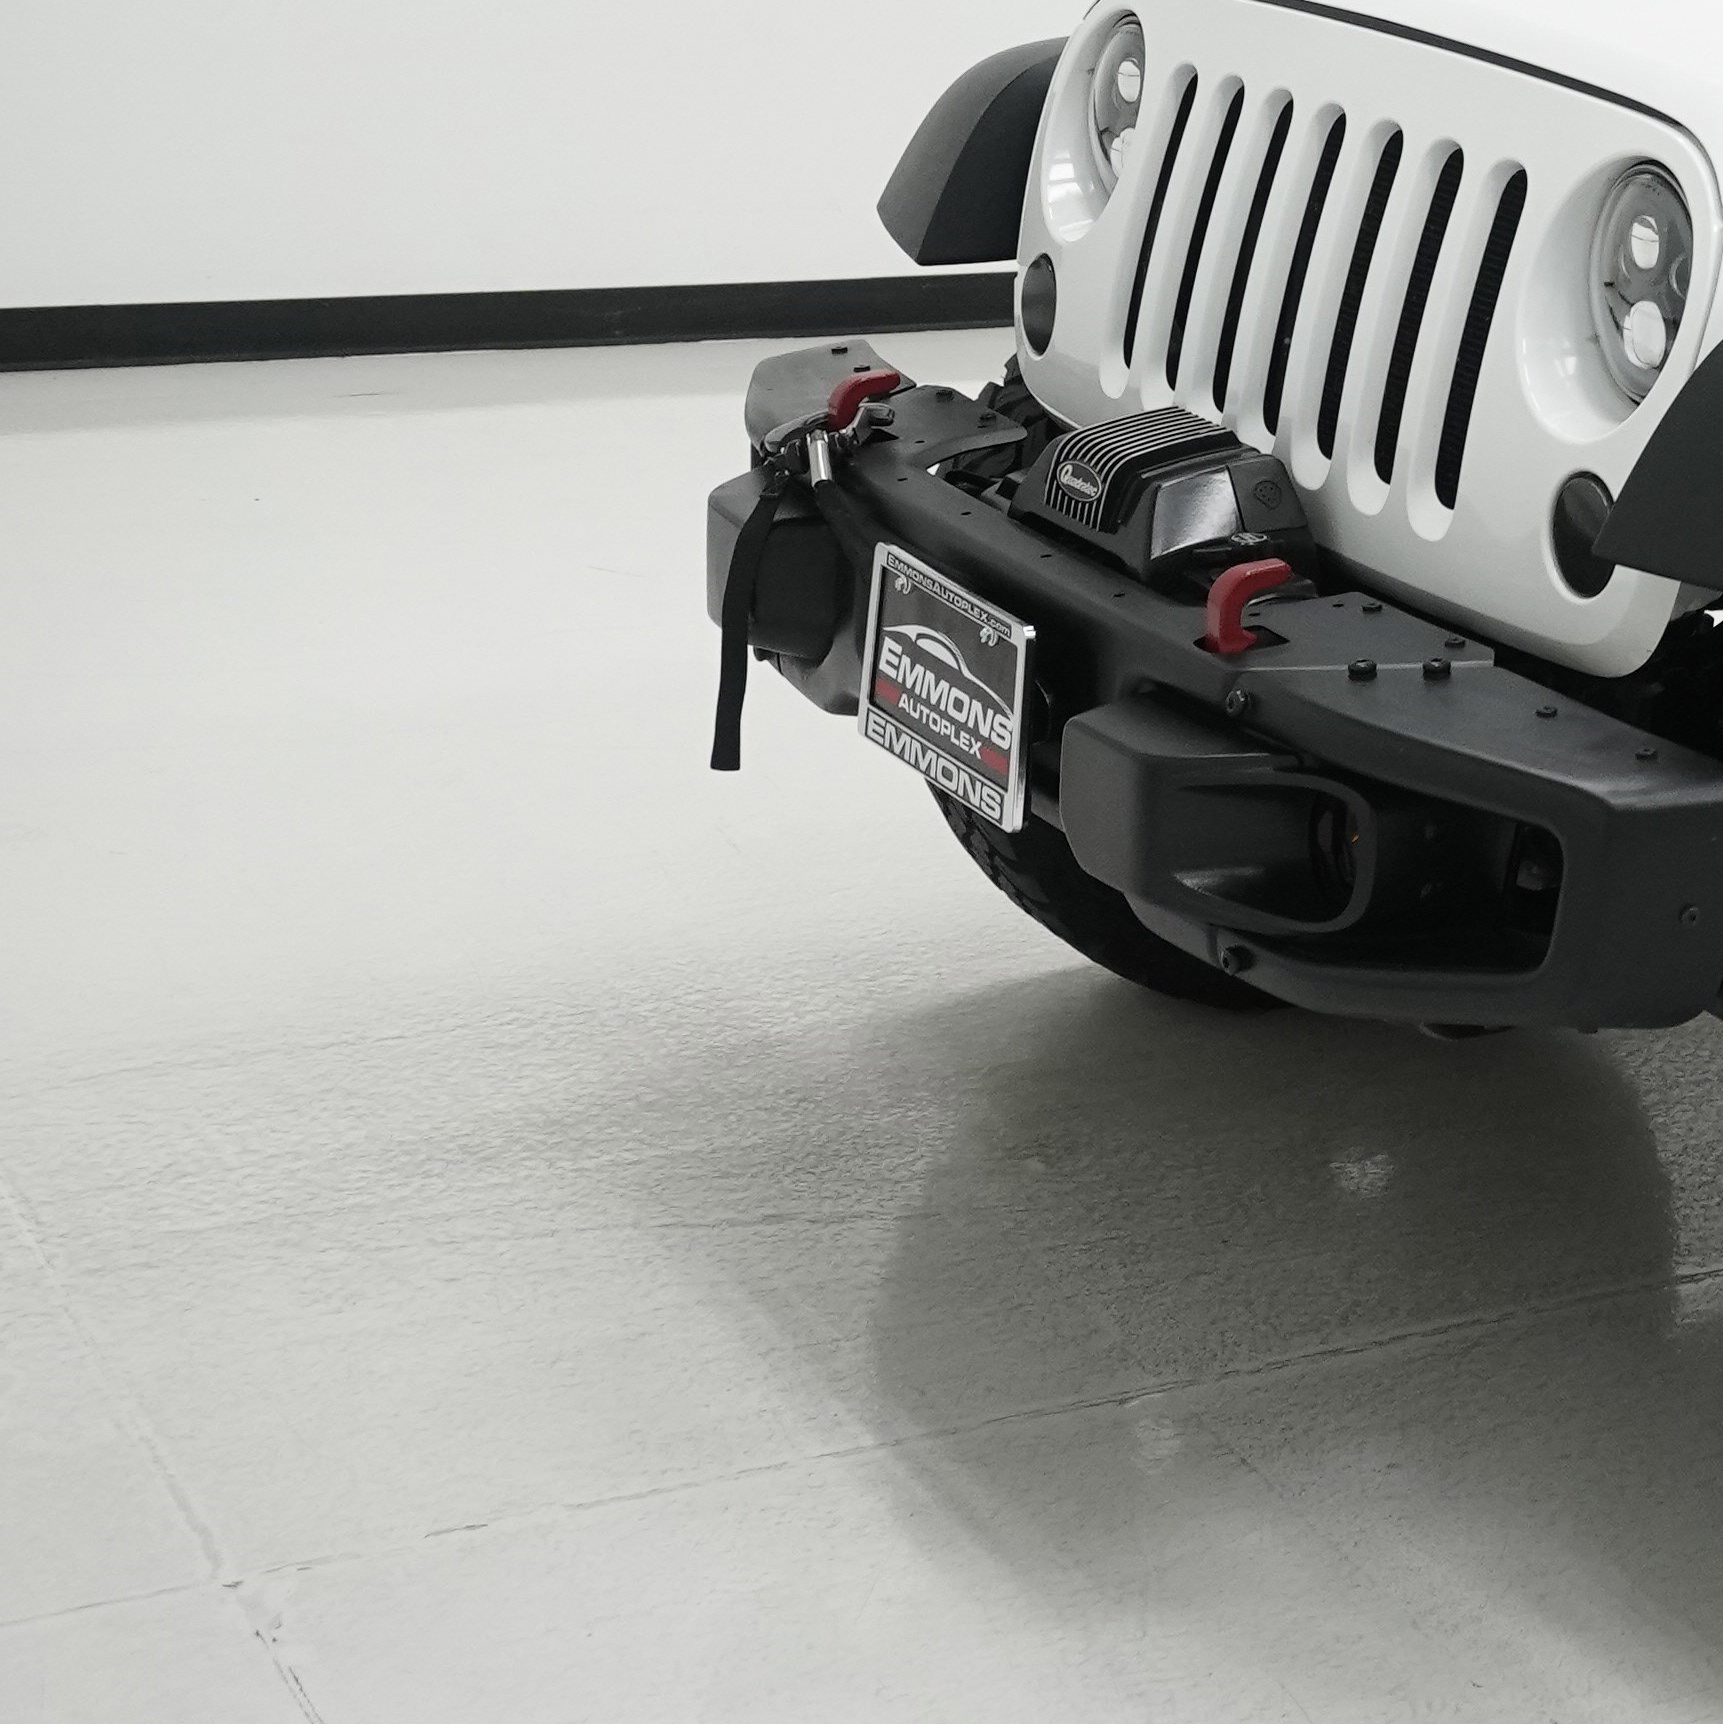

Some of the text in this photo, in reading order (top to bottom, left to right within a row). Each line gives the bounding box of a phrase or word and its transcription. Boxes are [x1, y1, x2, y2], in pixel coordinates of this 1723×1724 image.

[878, 636, 1014, 751] EMMONS
[898, 693, 982, 760] AUTOPLEX
[866, 710, 1002, 821] EMMONS
